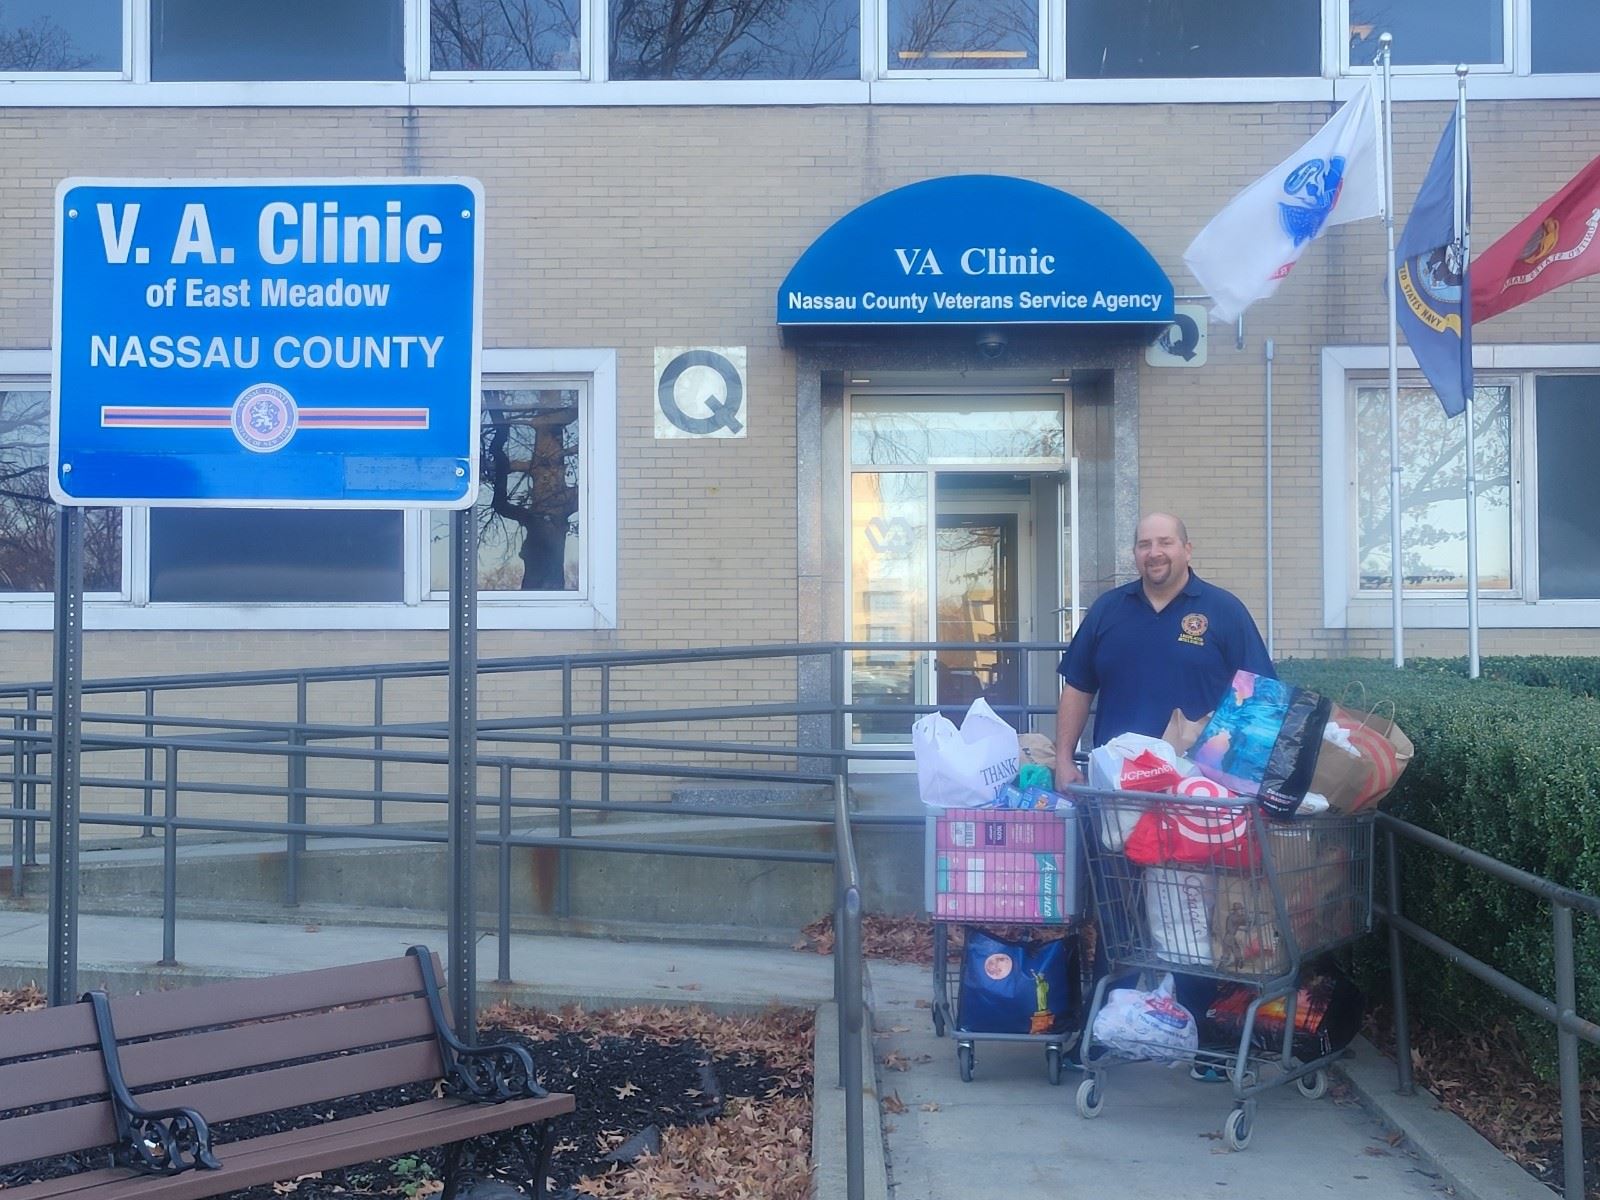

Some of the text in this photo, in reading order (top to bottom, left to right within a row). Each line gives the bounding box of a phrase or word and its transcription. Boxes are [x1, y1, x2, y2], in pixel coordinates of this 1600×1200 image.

[96, 200, 443, 265] V. A. Clinic
[895, 247, 1055, 275] VA Clinic
[146, 278, 390, 308] of East Meadow
[788, 290, 1163, 314] Nassau County Veterans Service Agency
[1403, 284, 1421, 311] STATES
[1420, 309, 1442, 327] NAVY
[90, 335, 444, 369] NASSAU COUNTY
[1160, 313, 1200, 362] Q
[657, 349, 744, 435] Q
[980, 757, 1018, 786] THANK
